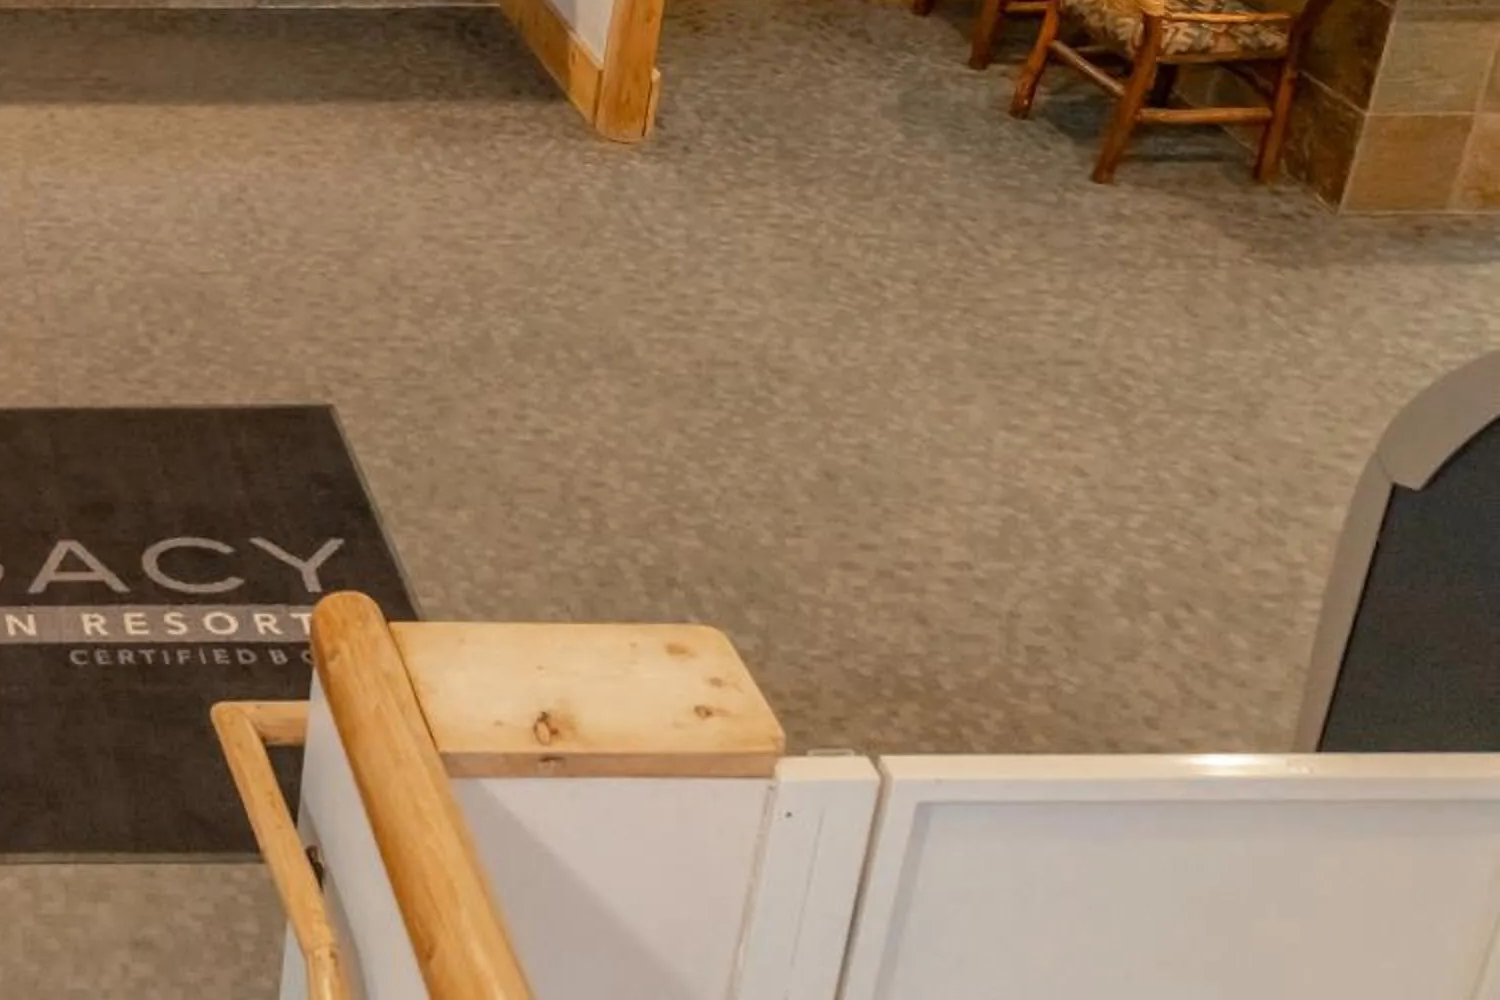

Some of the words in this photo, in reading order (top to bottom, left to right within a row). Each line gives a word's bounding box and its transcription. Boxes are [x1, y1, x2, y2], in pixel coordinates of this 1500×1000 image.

[80, 611, 312, 636] RESORT
[70, 648, 257, 666] CERTIFIED
[269, 648, 289, 665] B
